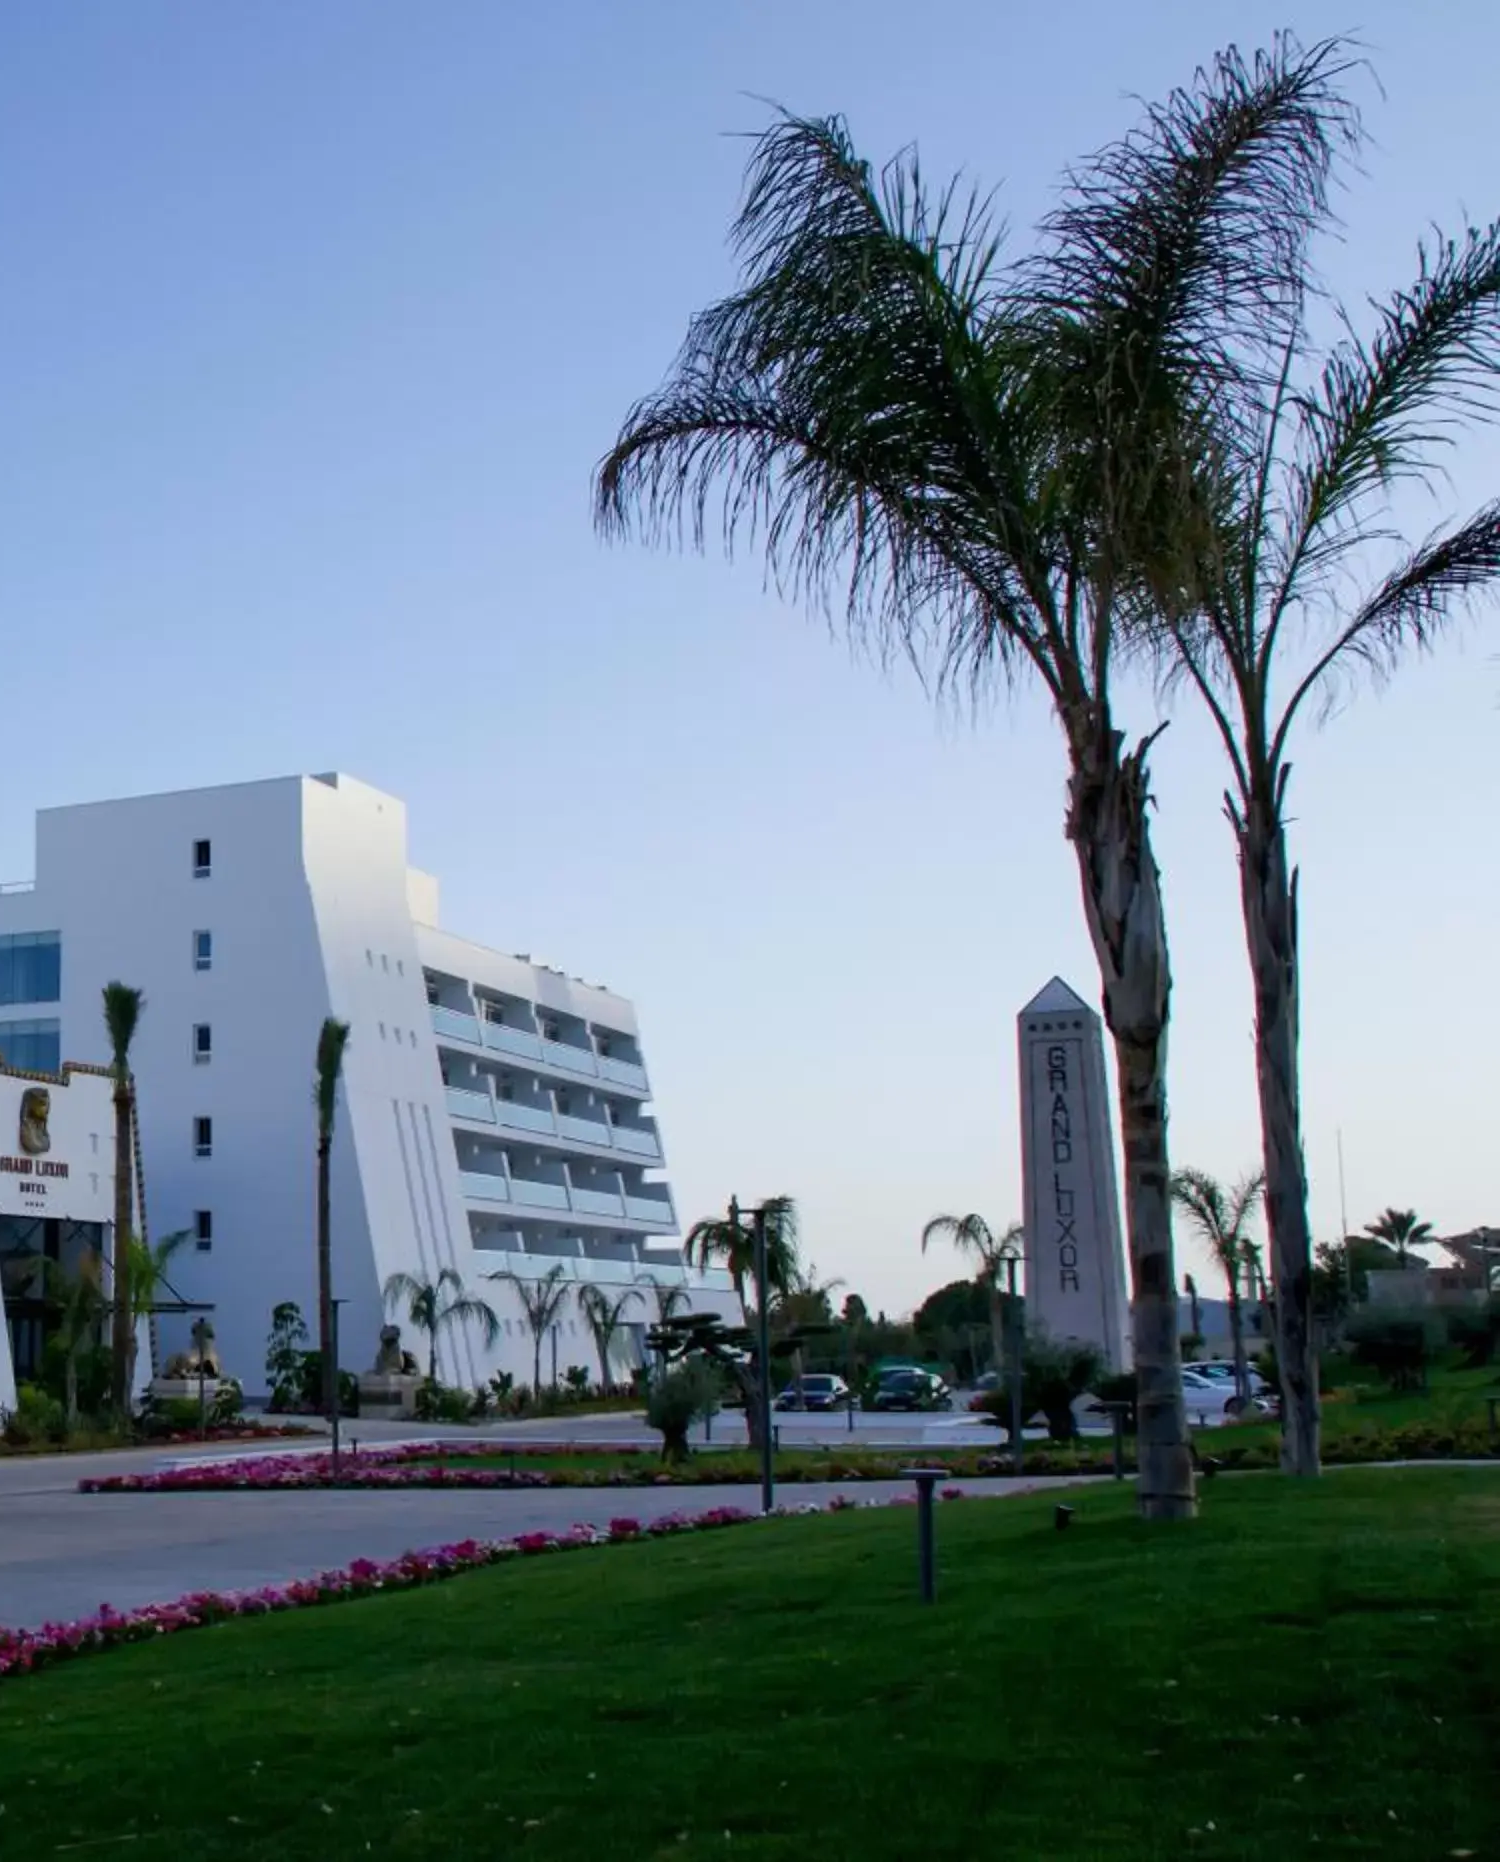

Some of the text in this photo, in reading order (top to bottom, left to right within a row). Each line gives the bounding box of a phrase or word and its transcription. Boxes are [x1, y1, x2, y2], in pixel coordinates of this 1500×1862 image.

[0, 1156, 68, 1179] GRAND LUXOR
[1047, 1047, 1079, 1292] GRAND LUXOR
[19, 1182, 47, 1194] HOTEL
